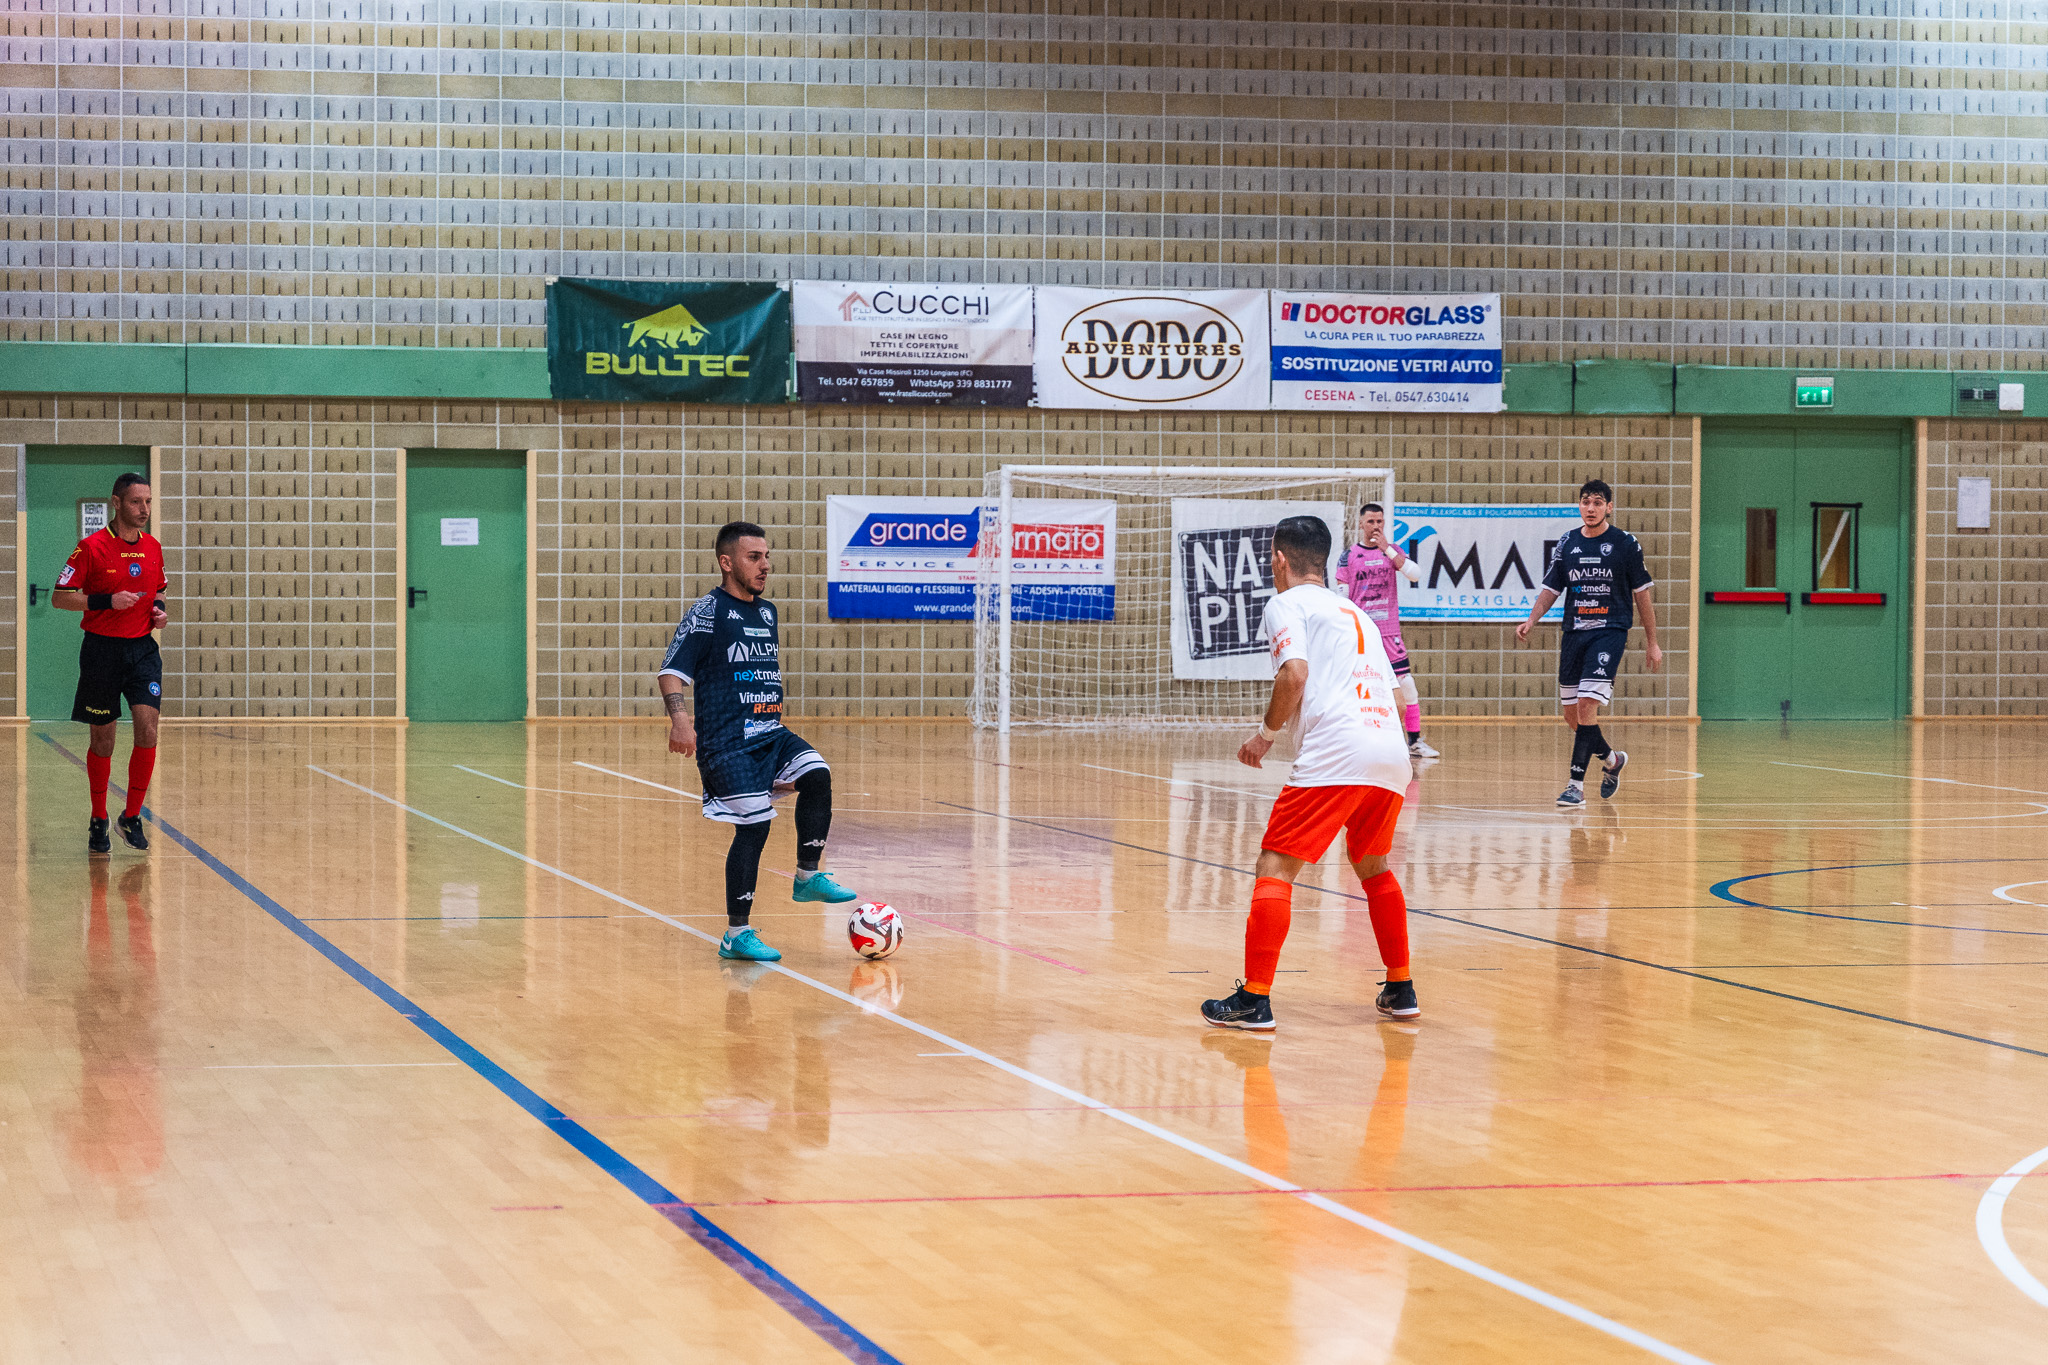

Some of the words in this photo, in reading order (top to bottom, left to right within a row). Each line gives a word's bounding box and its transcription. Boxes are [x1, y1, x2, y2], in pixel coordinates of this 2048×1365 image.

[873, 291, 989, 315] CUCCHI
[1304, 330, 1317, 340] LA
[1320, 331, 1349, 341] CURA
[1352, 332, 1374, 341] PER
[1377, 332, 1386, 341] IL
[1390, 333, 1412, 342] TUO
[1416, 332, 1485, 342] PARABREZZA
[906, 342, 959, 350] COPERTURE
[1065, 342, 1241, 356] ADVENTURES
[1082, 319, 1228, 380] DODO
[860, 351, 969, 359] IMPERMEABILIZZAZIONI
[586, 352, 750, 377] BULLTEC
[1281, 356, 1398, 372] SOSTITUZIONE
[1402, 359, 1447, 373] VETRI
[1450, 359, 1493, 373] AUTO
[930, 369, 959, 377] Longiano
[818, 377, 834, 386] Tel.
[836, 377, 858, 386] 0547
[861, 378, 894, 387] 657859
[909, 378, 954, 389] WhatsApp
[956, 380, 972, 388] 339
[974, 380, 1012, 389] 8831777
[1304, 390, 1355, 401] CESENA
[1369, 390, 1390, 403] Tel.
[1395, 390, 1470, 403] 0547.630414
[869, 517, 967, 546] grande
[840, 560, 955, 569] SERVICE
[1580, 568, 1613, 578] ALPHA
[839, 584, 884, 594] MATERIALI
[886, 585, 914, 594] RIGIDI
[923, 585, 966, 595] FLESSIBILI
[1029, 586, 1063, 595] ADESIVI
[1071, 587, 1103, 596] POSTER
[1339, 607, 1365, 655] 7
